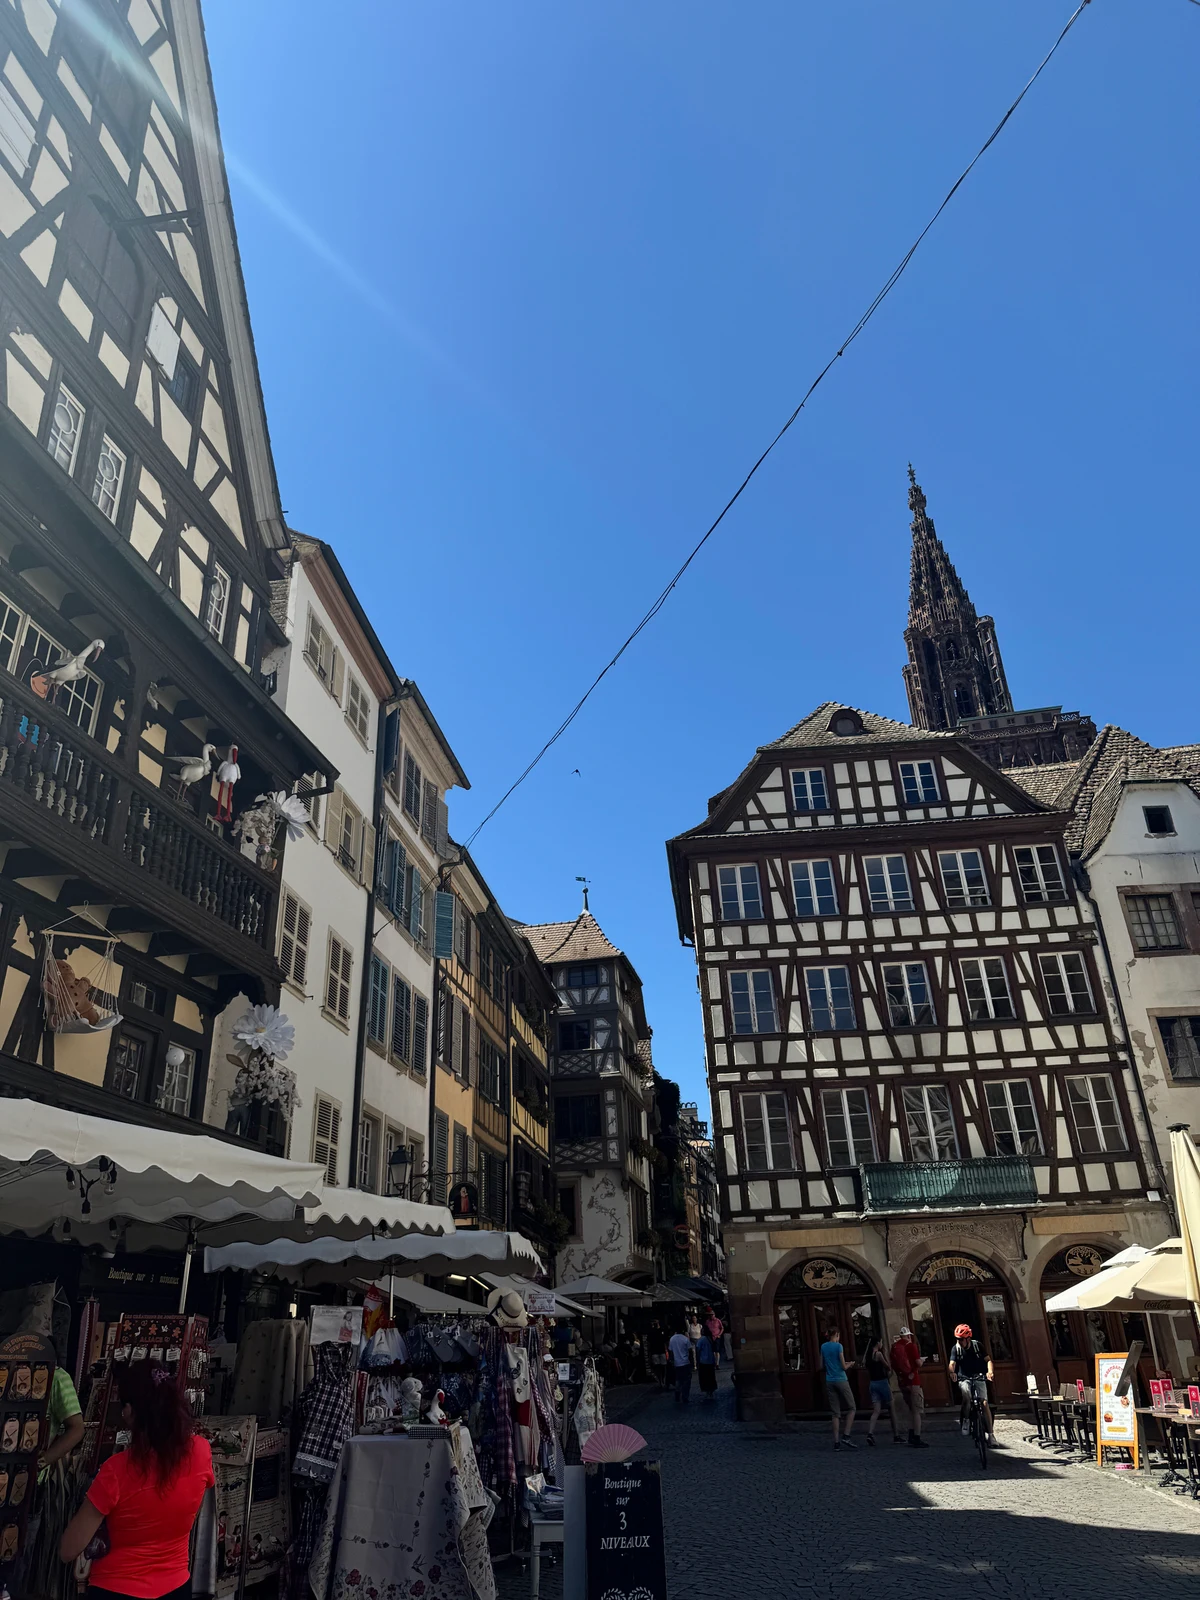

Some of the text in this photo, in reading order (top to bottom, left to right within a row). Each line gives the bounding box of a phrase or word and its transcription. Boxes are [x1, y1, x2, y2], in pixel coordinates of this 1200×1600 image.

[930, 1258, 975, 1271] ALSATRUCS
[107, 1267, 134, 1284] Boutique
[135, 1273, 146, 1281] sur
[604, 1476, 642, 1492] Boutique
[615, 1496, 630, 1506] sur
[619, 1511, 627, 1531] 3
[600, 1535, 650, 1550] NIVEAUX
